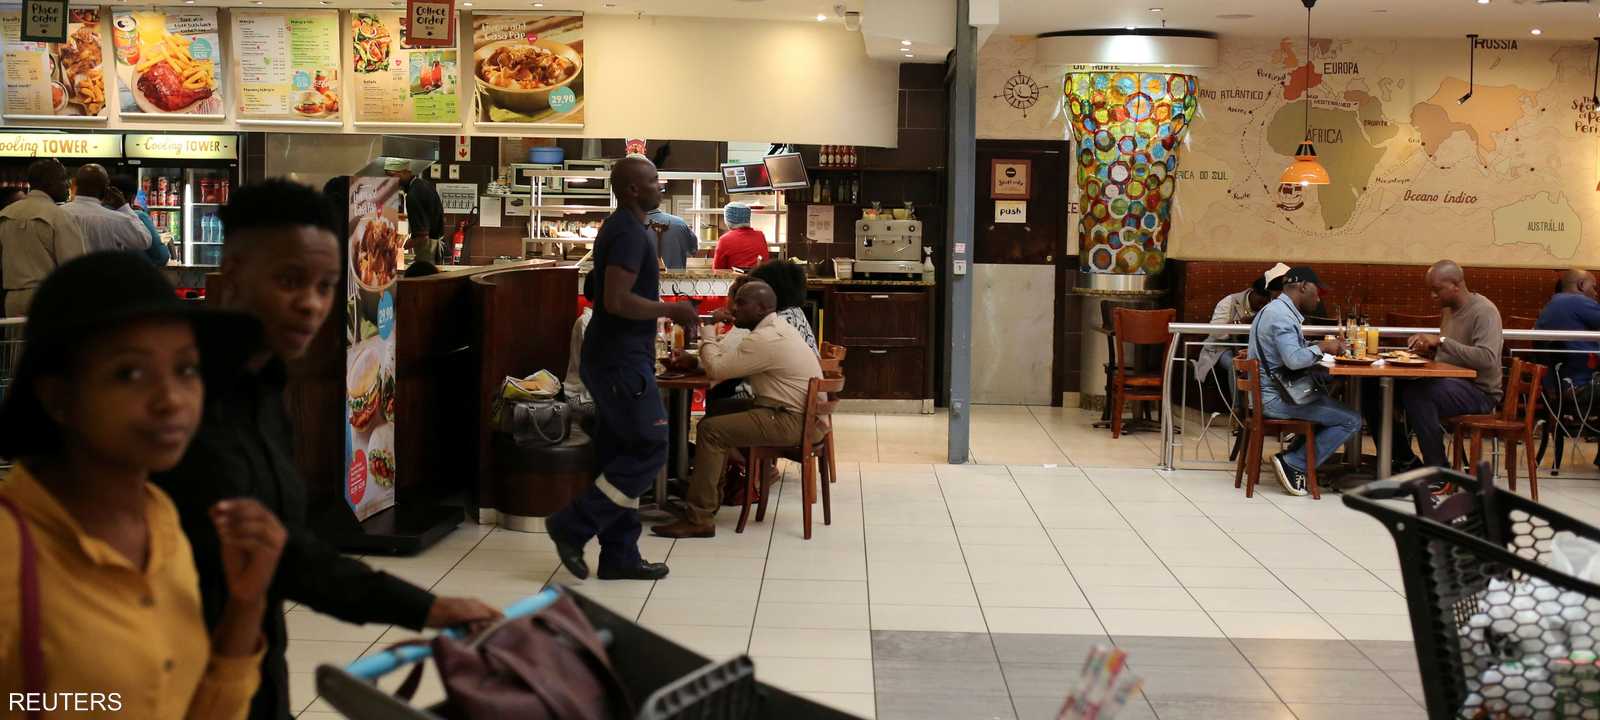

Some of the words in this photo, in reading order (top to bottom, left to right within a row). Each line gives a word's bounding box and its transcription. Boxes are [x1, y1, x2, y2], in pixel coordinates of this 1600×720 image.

[32, 3, 59, 14] Place
[416, 6, 446, 17] Collect
[416, 15, 445, 25] order
[1474, 38, 1518, 50] RUSSIA
[1324, 62, 1359, 75] EUROPA
[43, 140, 88, 153] TOWER
[186, 141, 220, 152] TOWER
[1403, 190, 1439, 202] Oceano
[1000, 208, 1021, 216] push
